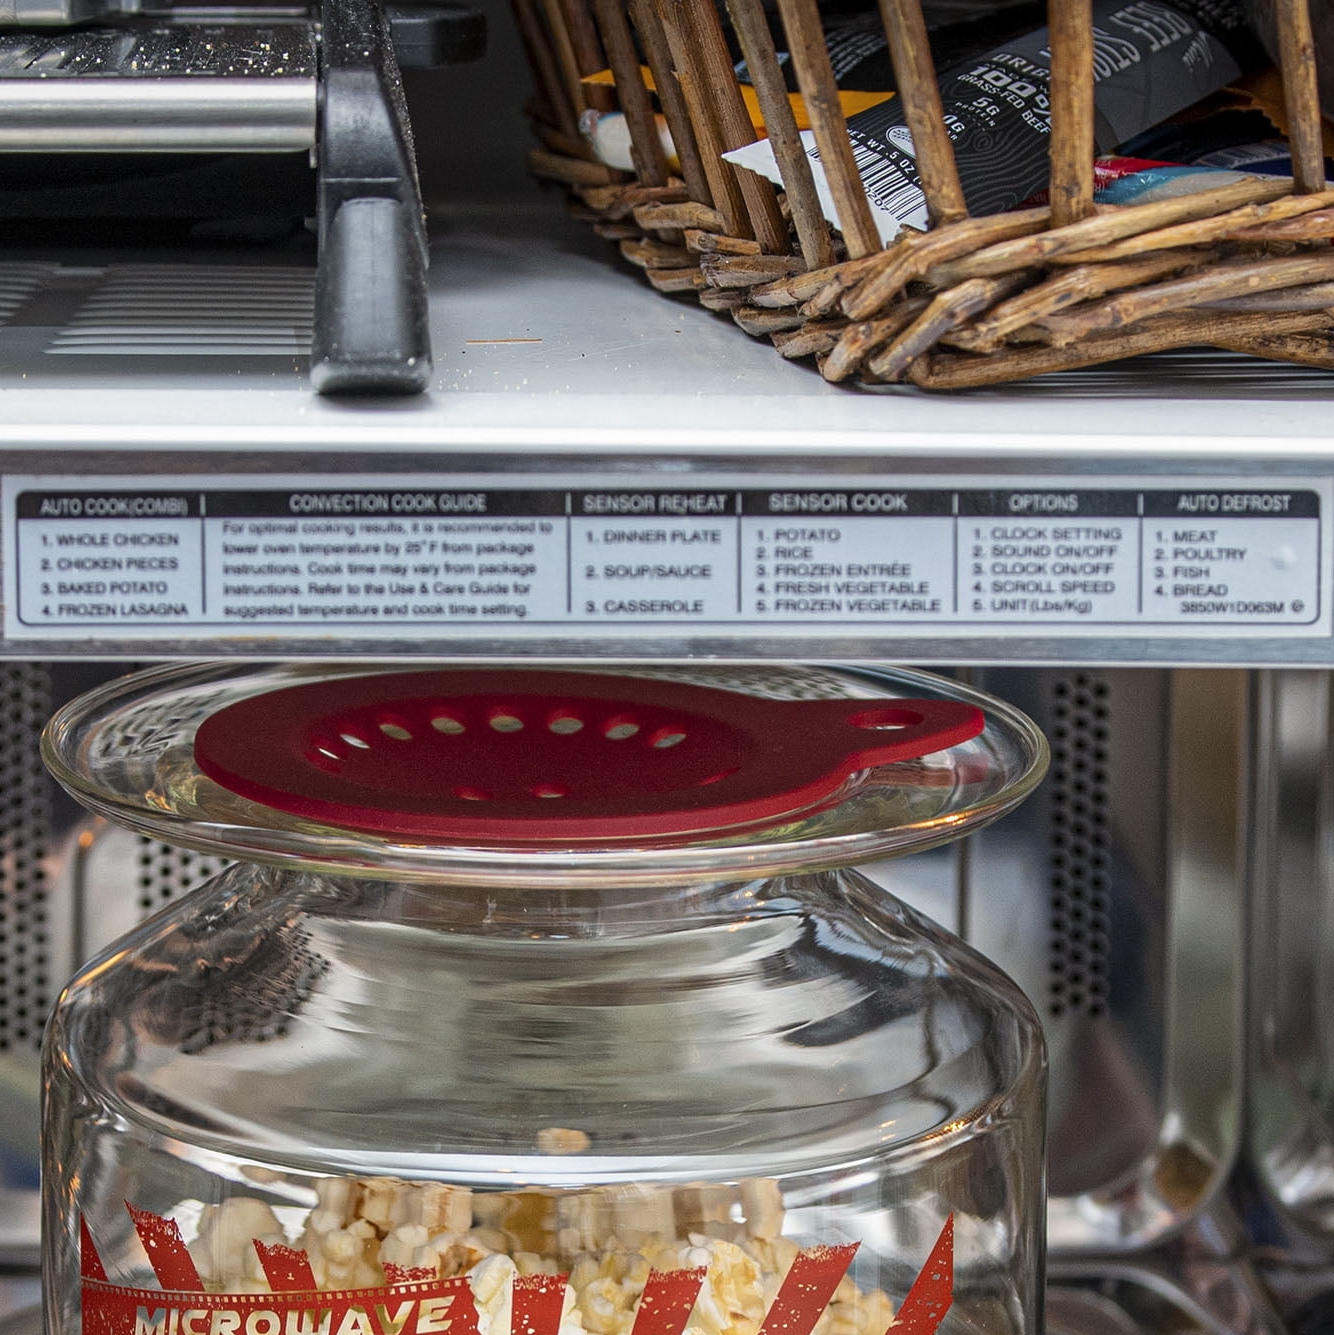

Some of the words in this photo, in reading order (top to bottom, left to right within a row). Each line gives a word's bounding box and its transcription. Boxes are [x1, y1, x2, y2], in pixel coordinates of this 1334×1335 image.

[992, 53, 1051, 80] ORIG
[957, 74, 1025, 109] GRASS-FED
[972, 97, 1000, 116] 5G
[289, 494, 389, 512] CONVECTION
[391, 494, 437, 512] COOK
[438, 494, 487, 512] GUIDE
[583, 494, 655, 513] SENSOR
[659, 494, 728, 514] REHEAT
[769, 493, 848, 511] SENSOR
[851, 493, 908, 511] COOK
[1009, 494, 1078, 512] OPTIONS
[1177, 494, 1219, 511] AUTO
[1221, 494, 1291, 511] DEFROST
[56, 533, 109, 546] WHOLE
[113, 533, 179, 546] CHICKEN
[603, 530, 666, 543] DINNER
[670, 530, 721, 543] PLATE
[775, 528, 841, 541] POTATO
[991, 527, 1048, 540] CLOCK
[1052, 527, 1123, 540] SETTING
[1173, 530, 1218, 542] MEAT
[775, 547, 814, 559] RICE
[992, 545, 1051, 557] SOUND
[1055, 545, 1118, 557] ON/OFF
[1173, 548, 1247, 560] POULTRY
[57, 557, 122, 570] CHICKEN
[126, 557, 179, 570] PIECES
[775, 564, 842, 577] FROZEN
[846, 560, 911, 577] ENTRÉE
[991, 563, 1048, 575] CLOCK
[1052, 562, 1114, 575] ON/OFF
[604, 565, 712, 578] SOUP/SAUCE
[1173, 566, 1211, 578] FISH
[57, 582, 106, 594] BAKED
[110, 581, 168, 594] POTATO
[775, 582, 830, 594] FRESH
[834, 582, 929, 594] VEGETABLE
[992, 581, 1055, 593] SCROLL
[1060, 581, 1115, 593] SPEED
[1173, 584, 1229, 597] BREAD
[57, 604, 116, 616] FROZEN
[120, 604, 188, 616] LASAGNA
[604, 600, 704, 613] CASSEROLE
[775, 600, 842, 612] FROZEN
[847, 600, 942, 612] VEGETABLE
